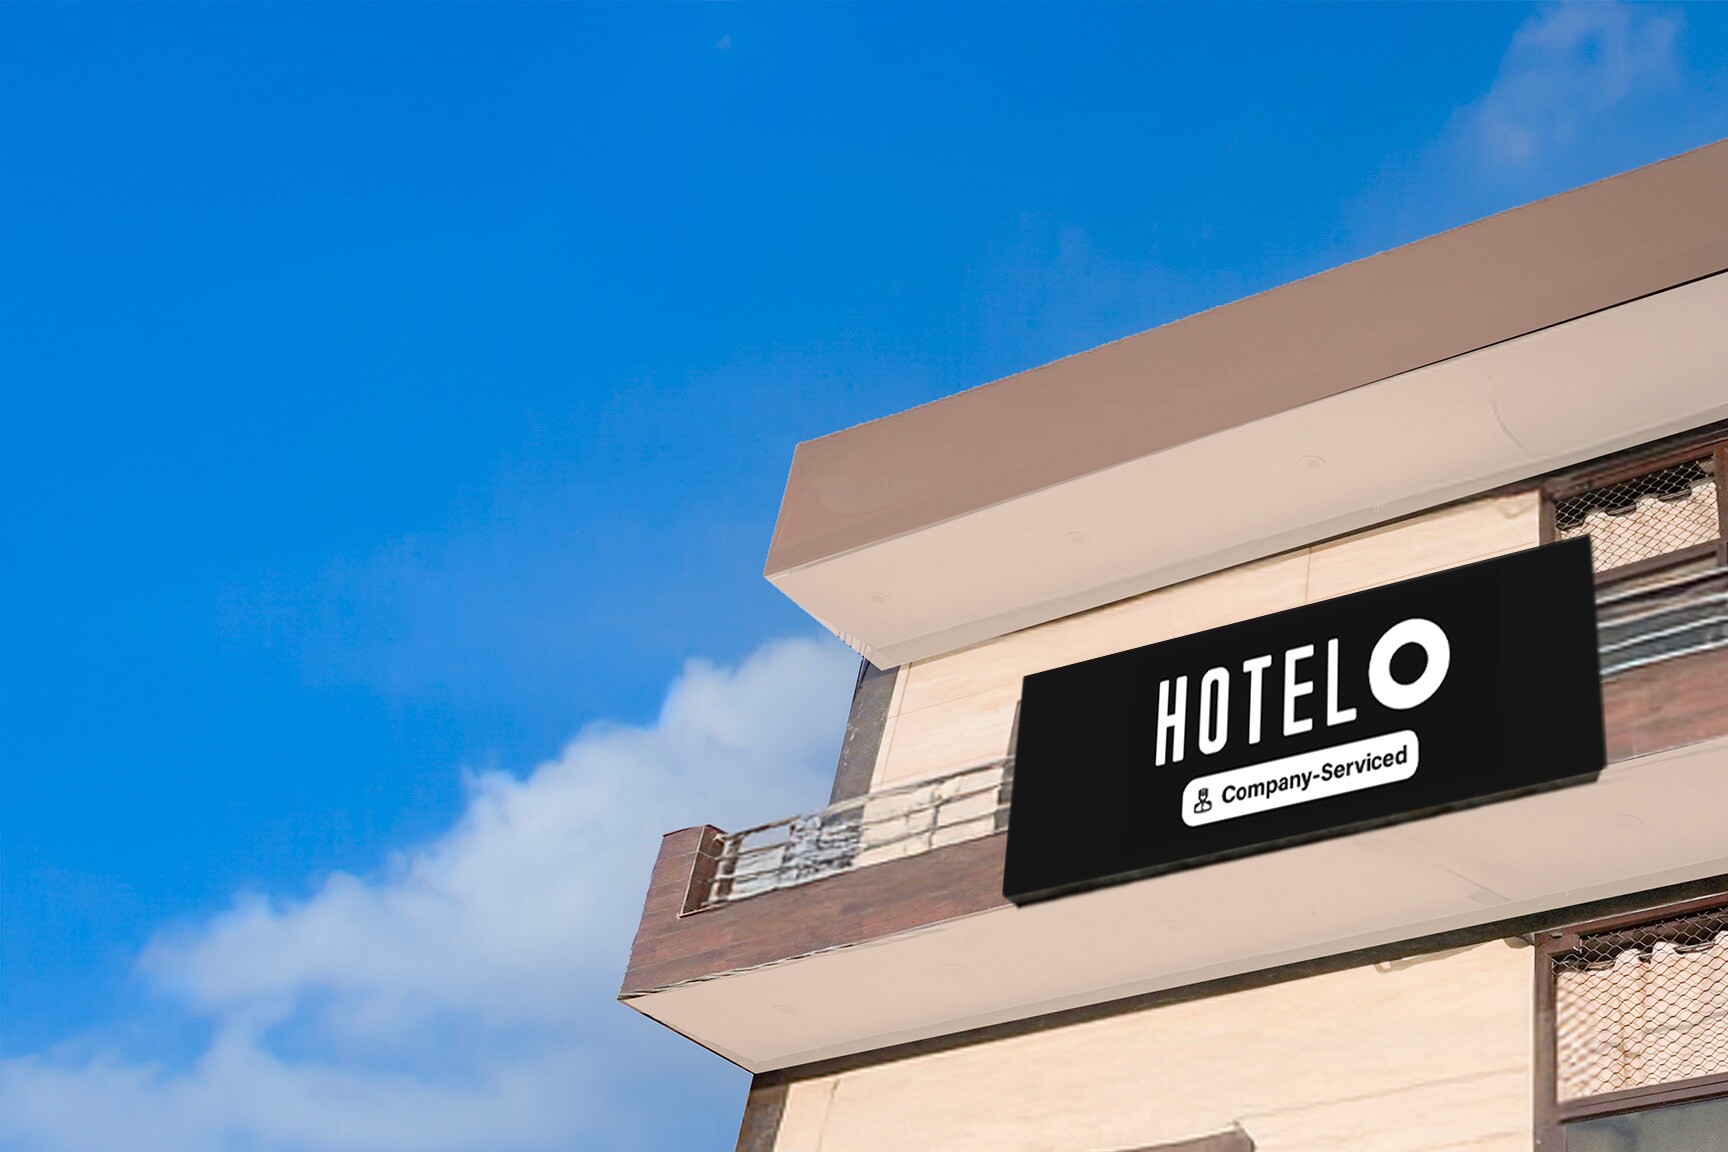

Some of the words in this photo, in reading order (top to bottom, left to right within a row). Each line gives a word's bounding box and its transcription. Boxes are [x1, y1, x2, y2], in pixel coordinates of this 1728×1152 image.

[1155, 638, 1357, 767] HOTEL
[1368, 618, 1451, 710] O
[1221, 745, 1408, 805] Company-Serviced
